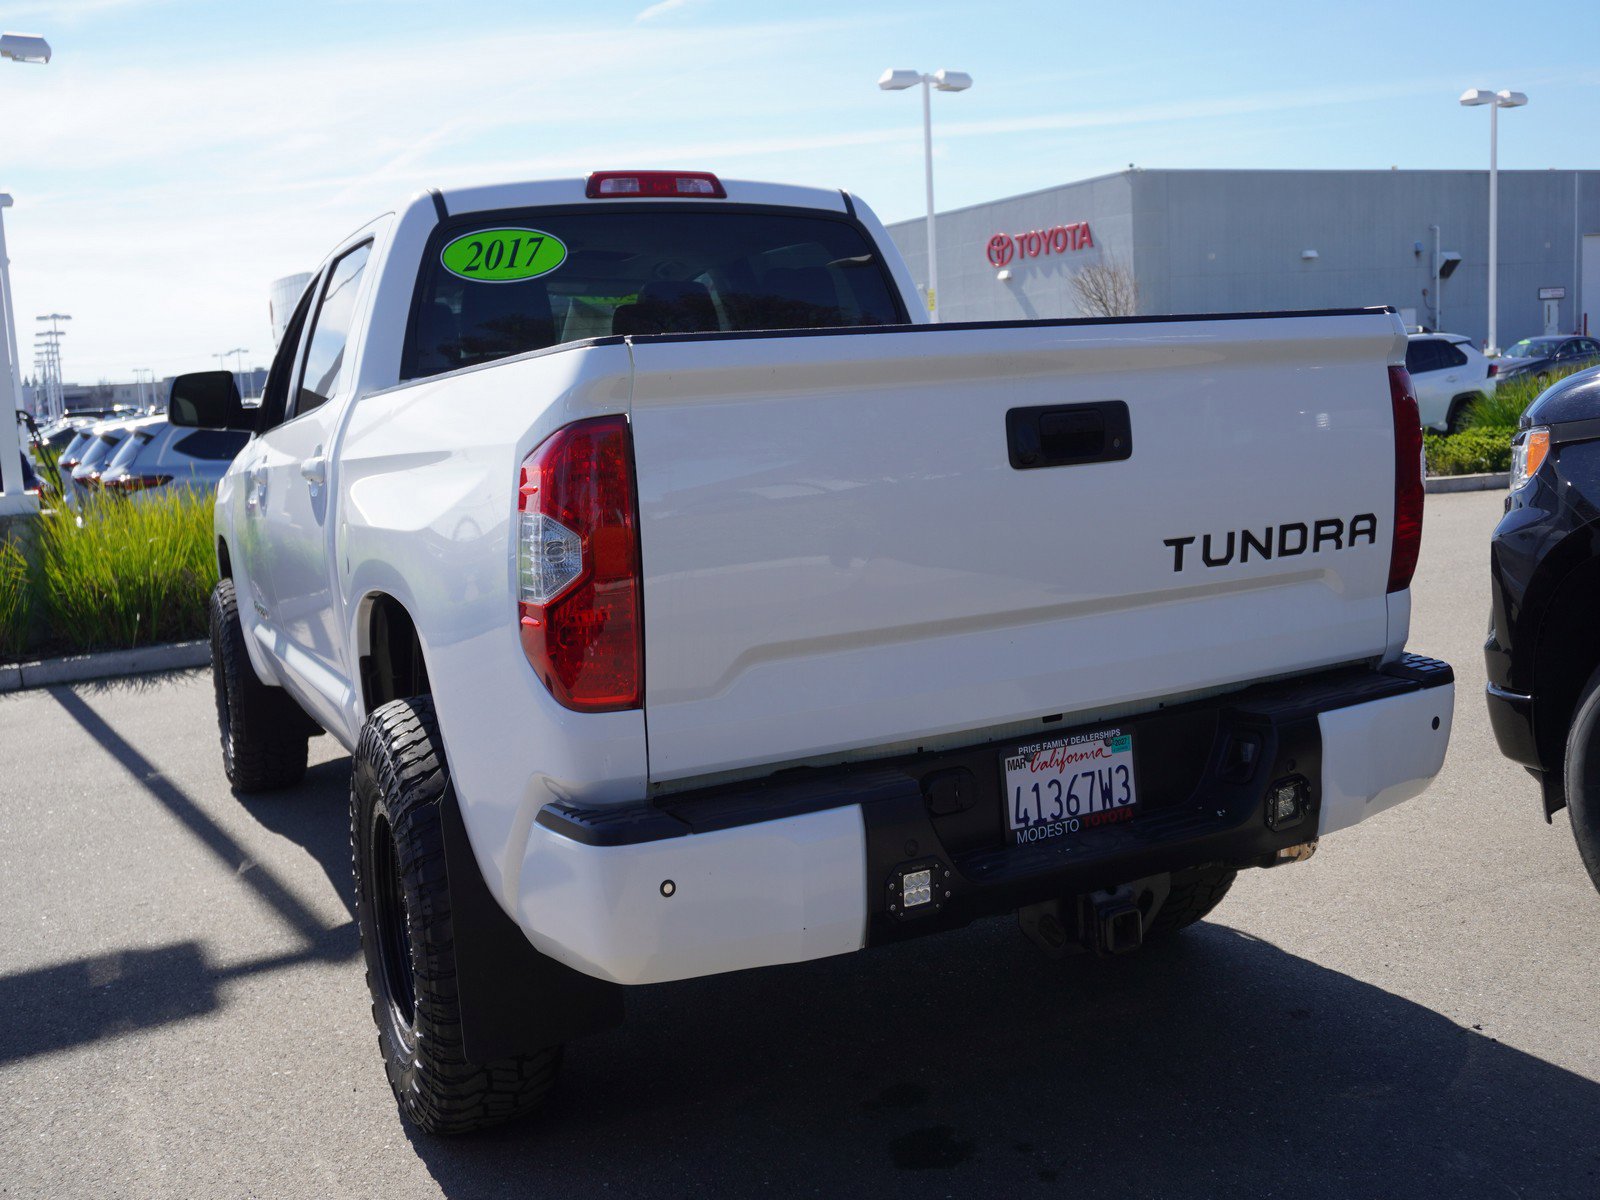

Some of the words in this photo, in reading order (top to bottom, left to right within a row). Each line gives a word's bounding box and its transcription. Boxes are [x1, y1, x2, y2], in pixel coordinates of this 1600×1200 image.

[462, 236, 545, 272] 2017
[1015, 221, 1094, 259] TOYOTA
[1163, 512, 1377, 572] TUNDRA
[1018, 744, 1041, 755] PRICE
[1042, 738, 1069, 751] FAMILY
[1070, 728, 1121, 746] DEALERSHIPS
[1030, 744, 1113, 774] California
[1007, 757, 1027, 772] MAR
[1015, 764, 1131, 826] 41367W3
[1017, 819, 1080, 844] MODESTO
[1082, 807, 1134, 828] TOYOTA
